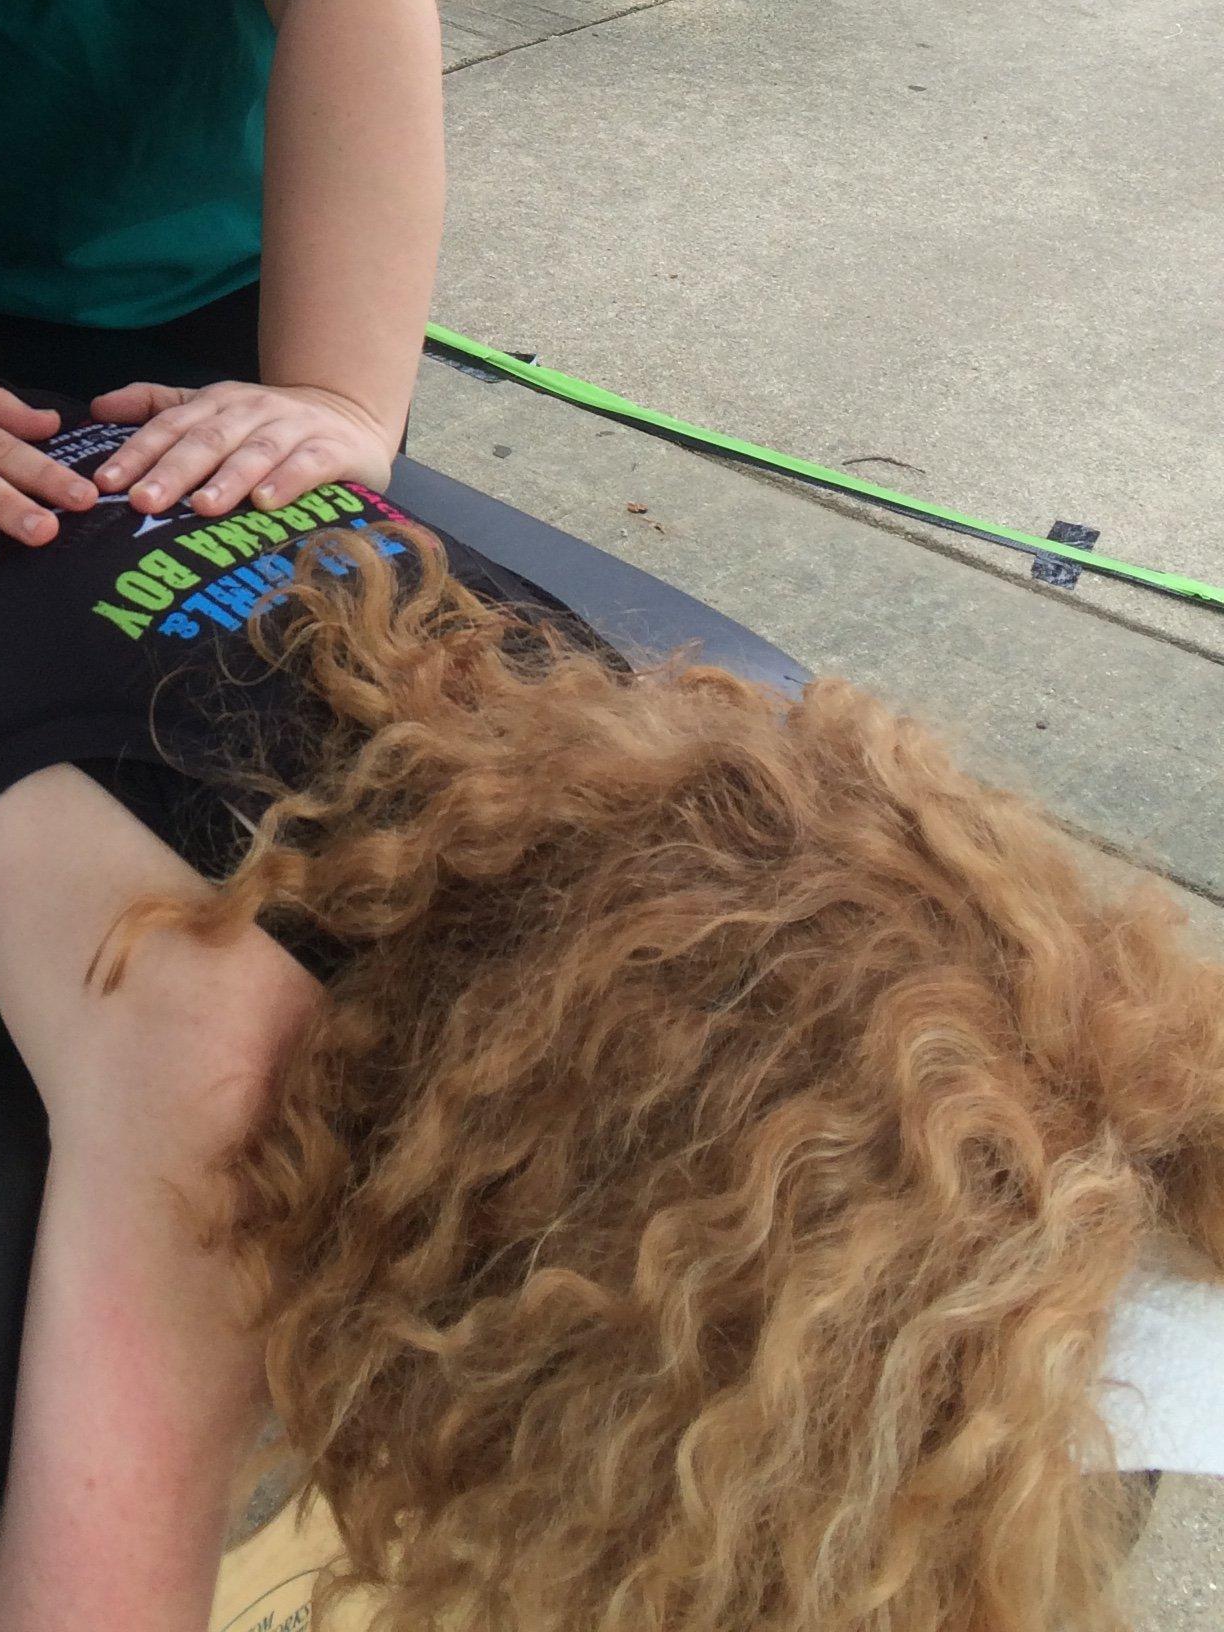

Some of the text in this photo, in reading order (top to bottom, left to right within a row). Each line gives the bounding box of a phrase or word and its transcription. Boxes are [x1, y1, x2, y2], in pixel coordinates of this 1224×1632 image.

[174, 483, 365, 568] CABANA
[91, 548, 202, 641] BOY
[158, 612, 200, 640] &
